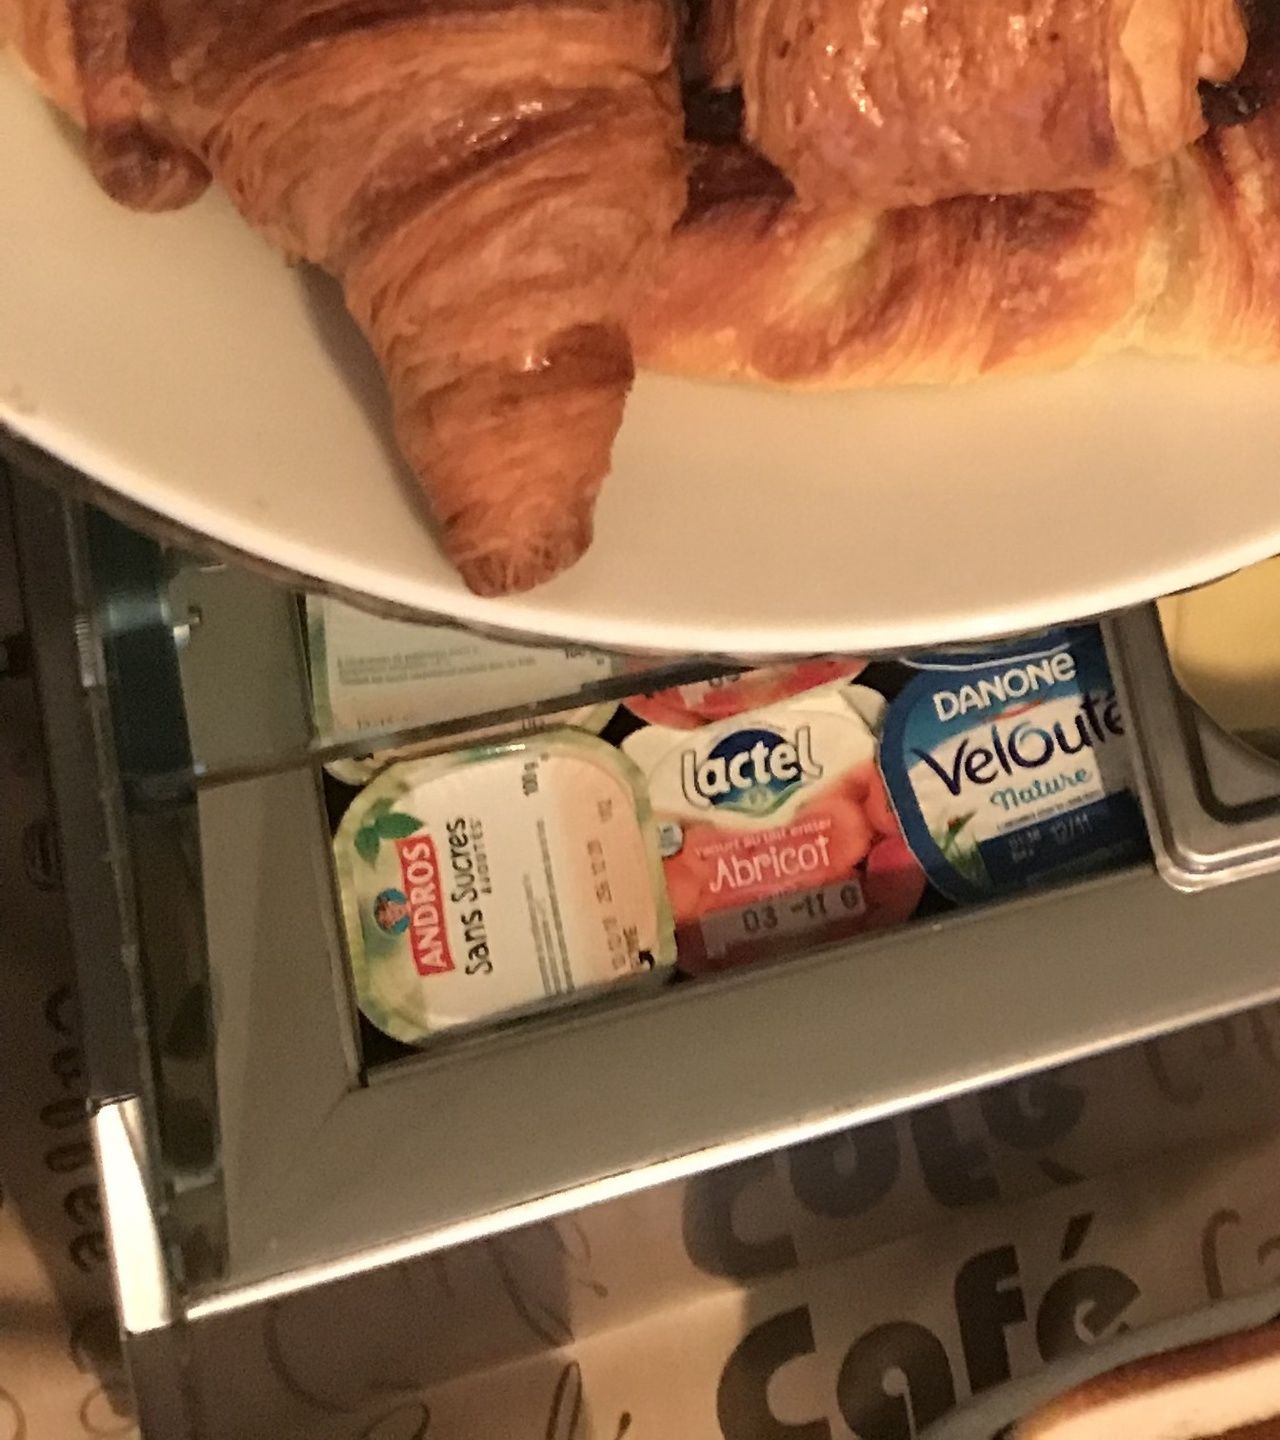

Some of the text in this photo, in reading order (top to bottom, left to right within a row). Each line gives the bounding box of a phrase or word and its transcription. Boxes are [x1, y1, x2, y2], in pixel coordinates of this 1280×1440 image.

[933, 651, 1077, 722] DANONE
[682, 725, 824, 810] lactel
[403, 841, 446, 971] ANDROS
[446, 817, 494, 976] Sans Sucres
[709, 834, 831, 894] Abricot
[716, 1213, 1142, 1440] Café
